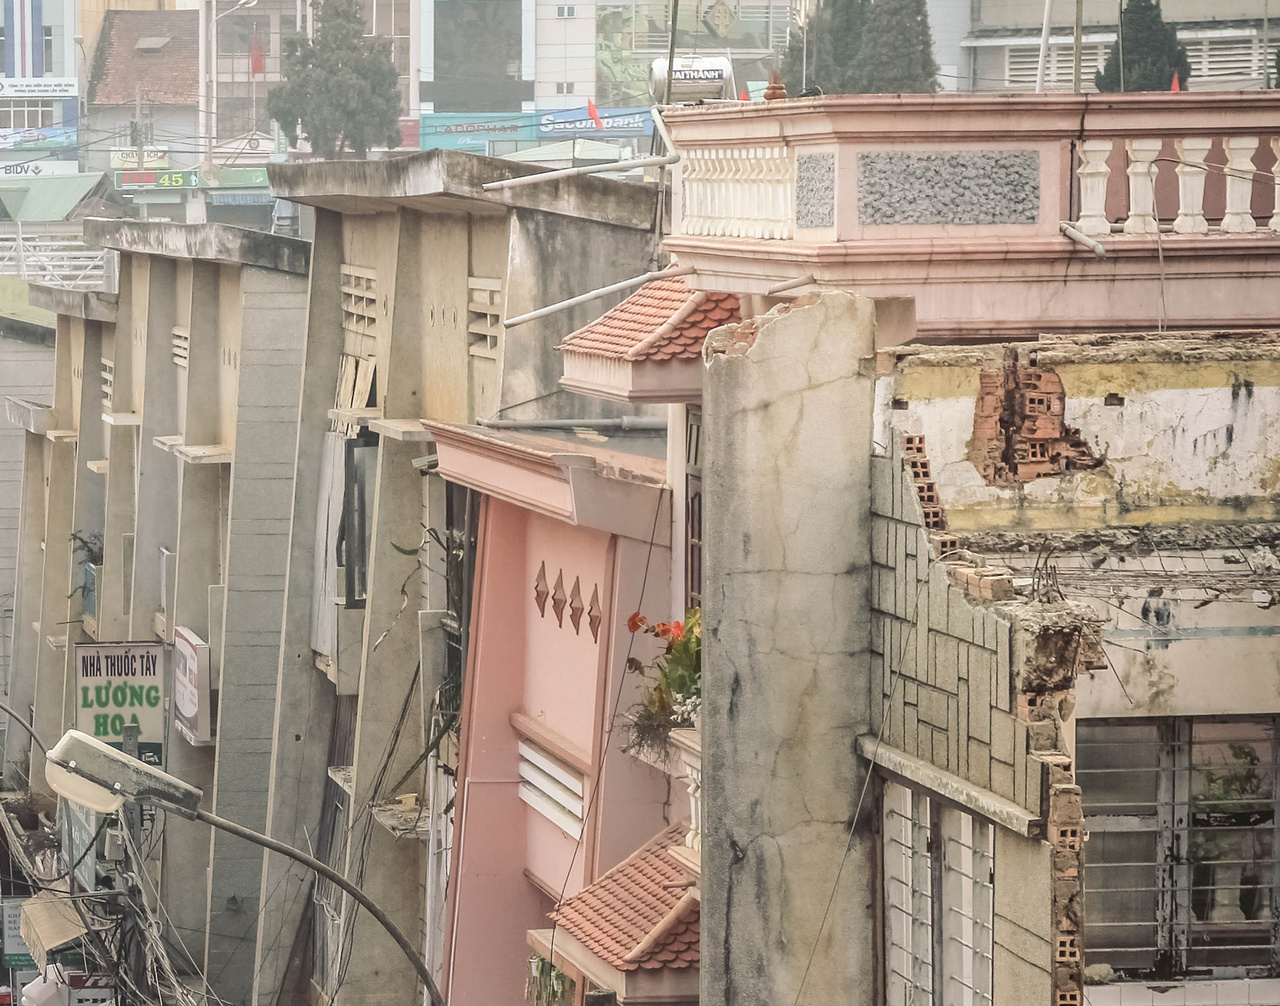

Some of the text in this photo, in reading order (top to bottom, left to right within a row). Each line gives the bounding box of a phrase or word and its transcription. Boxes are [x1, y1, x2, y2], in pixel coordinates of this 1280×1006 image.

[4, 165, 30, 174] BIDV
[159, 174, 183, 186] 45
[82, 648, 157, 677] NHÀ THUỐC TÂY
[81, 680, 160, 708] LƯƠNG
